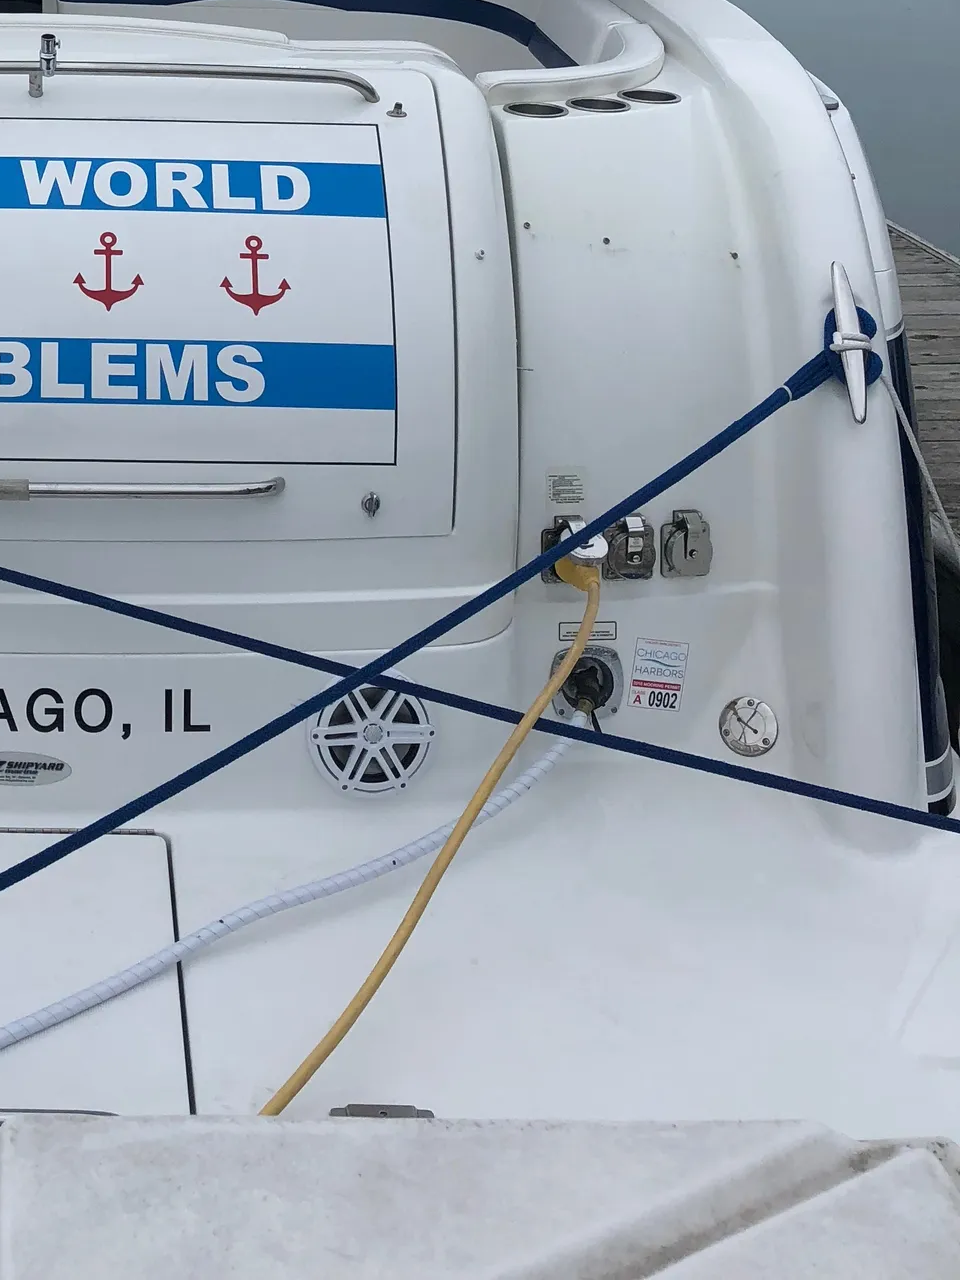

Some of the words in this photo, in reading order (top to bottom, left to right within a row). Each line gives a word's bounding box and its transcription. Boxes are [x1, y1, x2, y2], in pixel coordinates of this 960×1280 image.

[20, 160, 311, 213] WORLD
[636, 648, 687, 662] CHICAGO
[634, 665, 684, 679] HARBORS
[633, 694, 642, 705] A
[648, 690, 678, 709] 0902
[164, 688, 211, 732] IL
[6, 760, 65, 771] SHIPYARD
